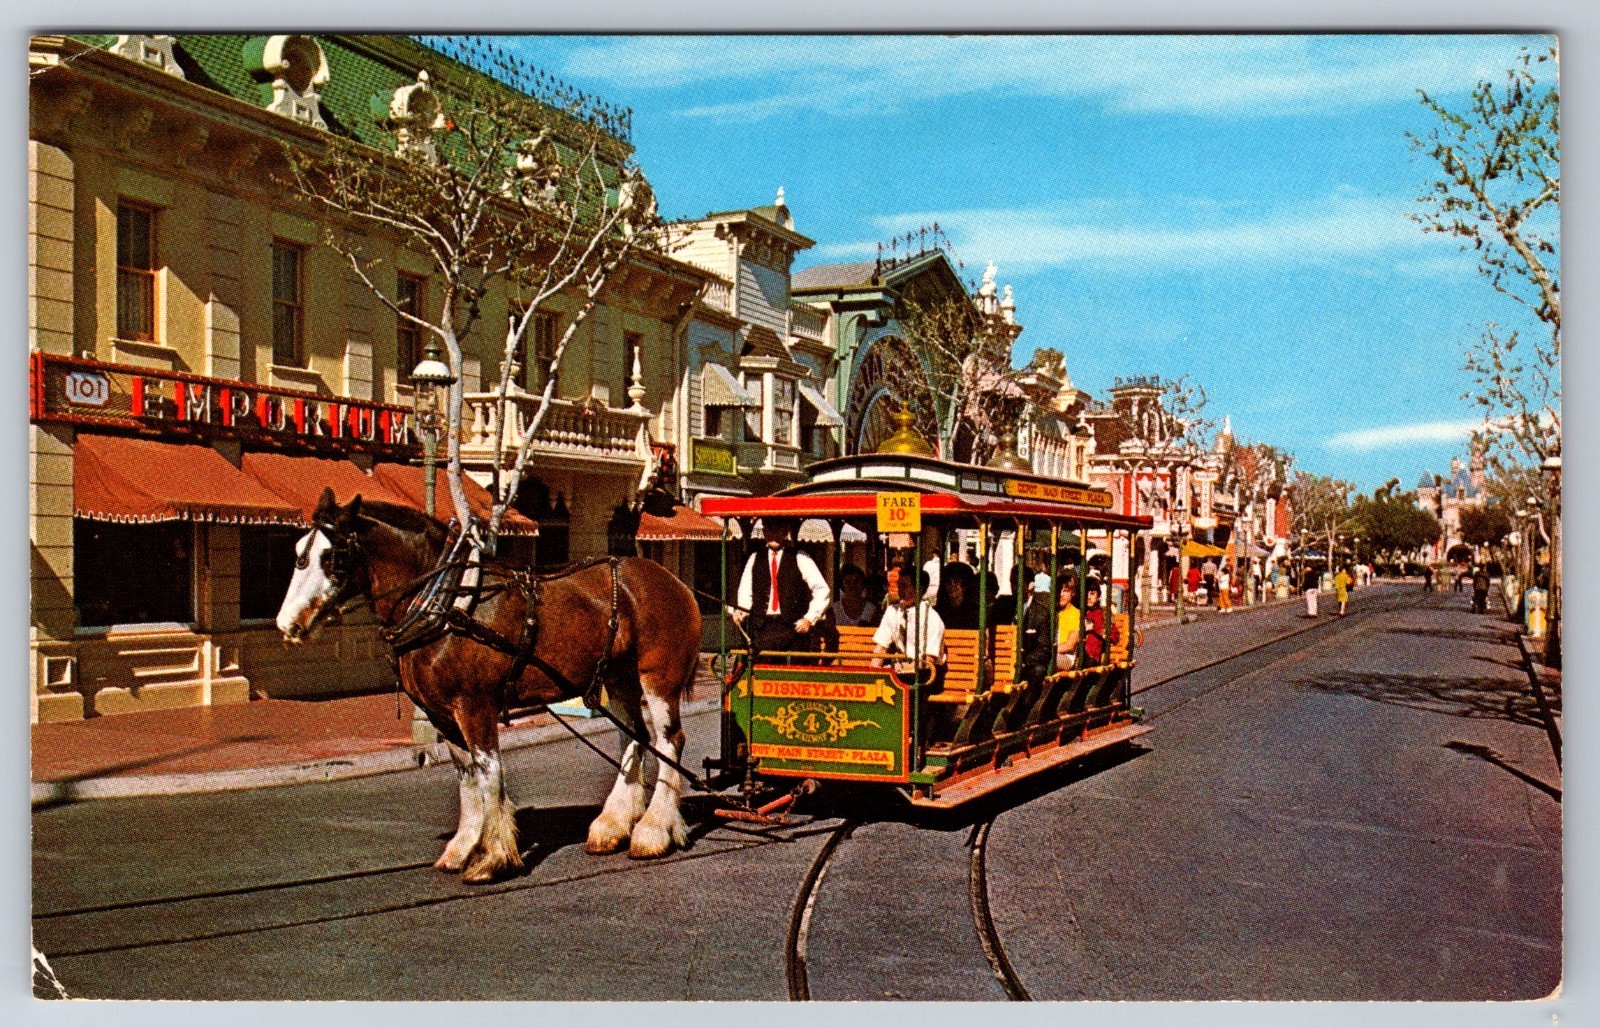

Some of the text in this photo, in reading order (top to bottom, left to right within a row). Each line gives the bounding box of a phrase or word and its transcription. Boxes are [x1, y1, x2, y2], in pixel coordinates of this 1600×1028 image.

[72, 376, 102, 399] 101
[132, 376, 409, 445] EMPORIUM
[883, 497, 915, 507] FARE
[762, 682, 866, 698] DISNEYLAND
[803, 713, 820, 733] 4
[752, 745, 889, 762] POT MAIN STREET PLAZA
